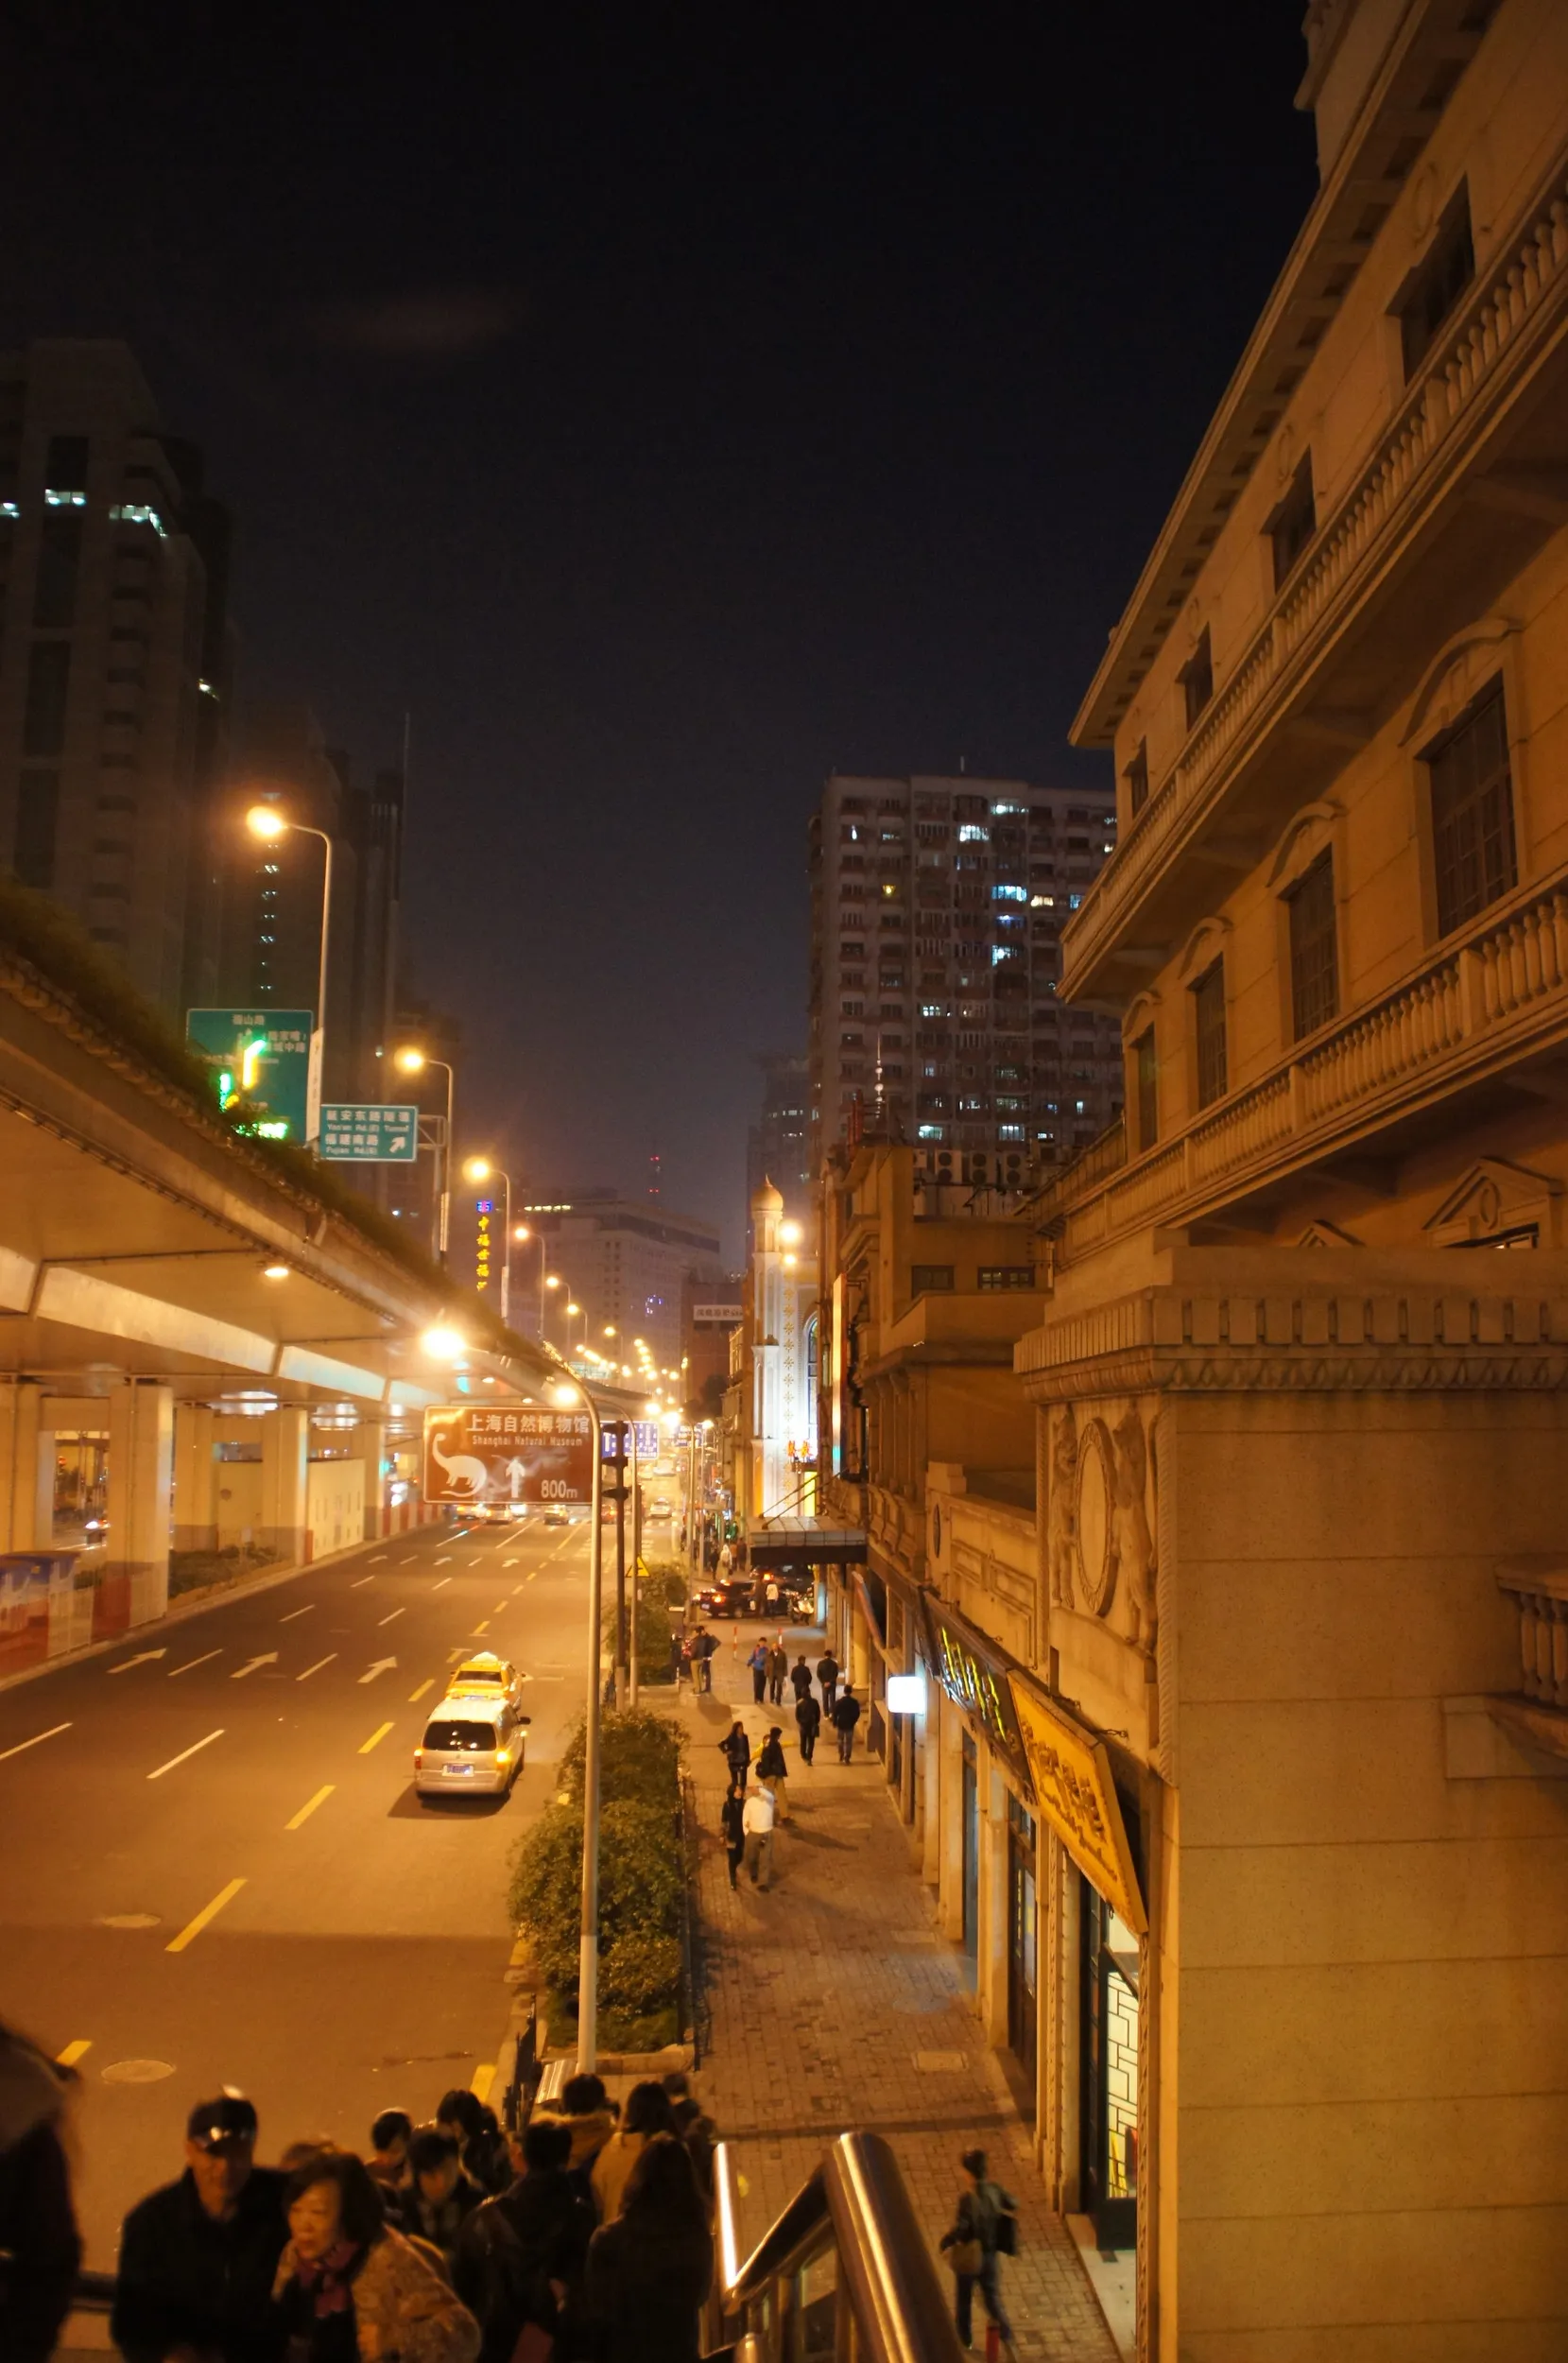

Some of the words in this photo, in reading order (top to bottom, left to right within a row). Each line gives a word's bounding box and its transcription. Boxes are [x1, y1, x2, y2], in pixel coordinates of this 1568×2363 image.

[465, 1413, 590, 1434] 上海自然博物馆
[472, 1435, 511, 1447] Shanghai
[514, 1436, 545, 1446] Natural
[550, 1436, 583, 1446] Museum
[541, 1479, 578, 1499] 800m
